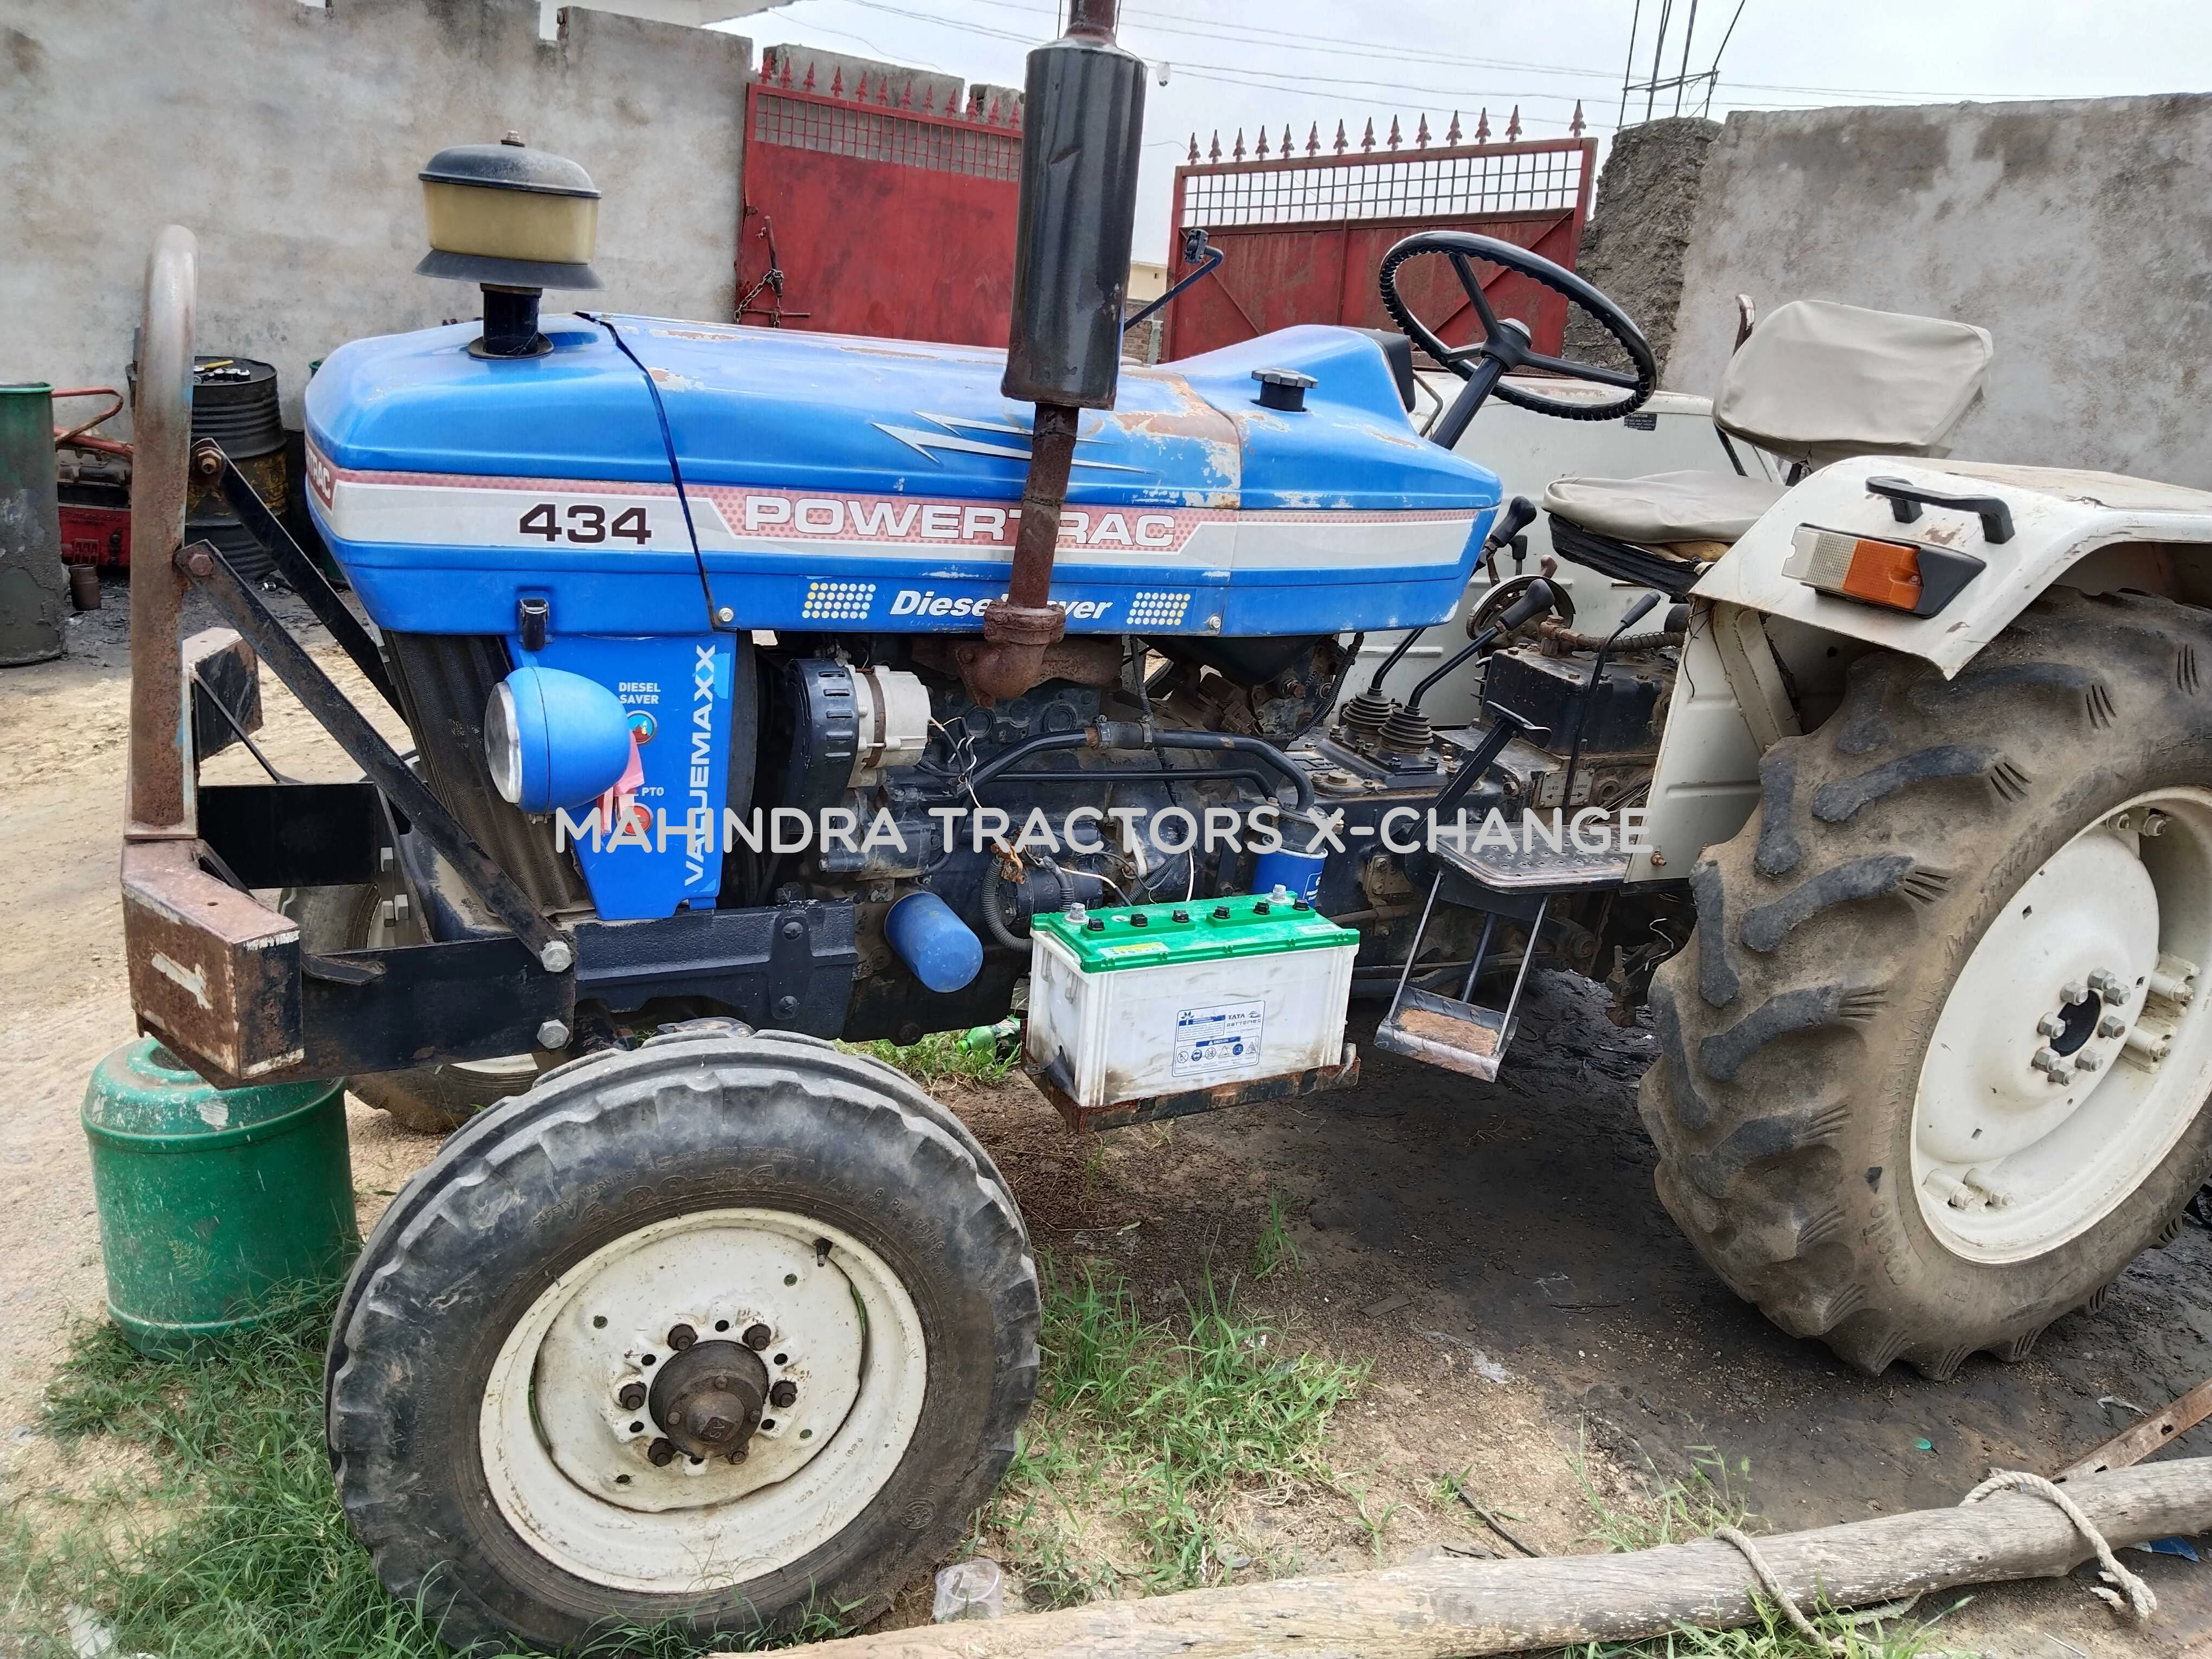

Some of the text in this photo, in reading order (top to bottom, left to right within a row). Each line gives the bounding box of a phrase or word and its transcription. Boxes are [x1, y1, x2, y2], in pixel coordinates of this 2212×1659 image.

[519, 503, 652, 545] 434
[744, 494, 1175, 548] POWERRAC
[619, 682, 661, 692] DIESEL
[620, 694, 659, 704] SAVER
[685, 645, 715, 886] VALUEMAXX
[641, 787, 664, 796] PTO
[532, 1199, 573, 1229] SAFETY
[890, 1197, 911, 1213] PLY
[915, 1218, 946, 1250] RATING
